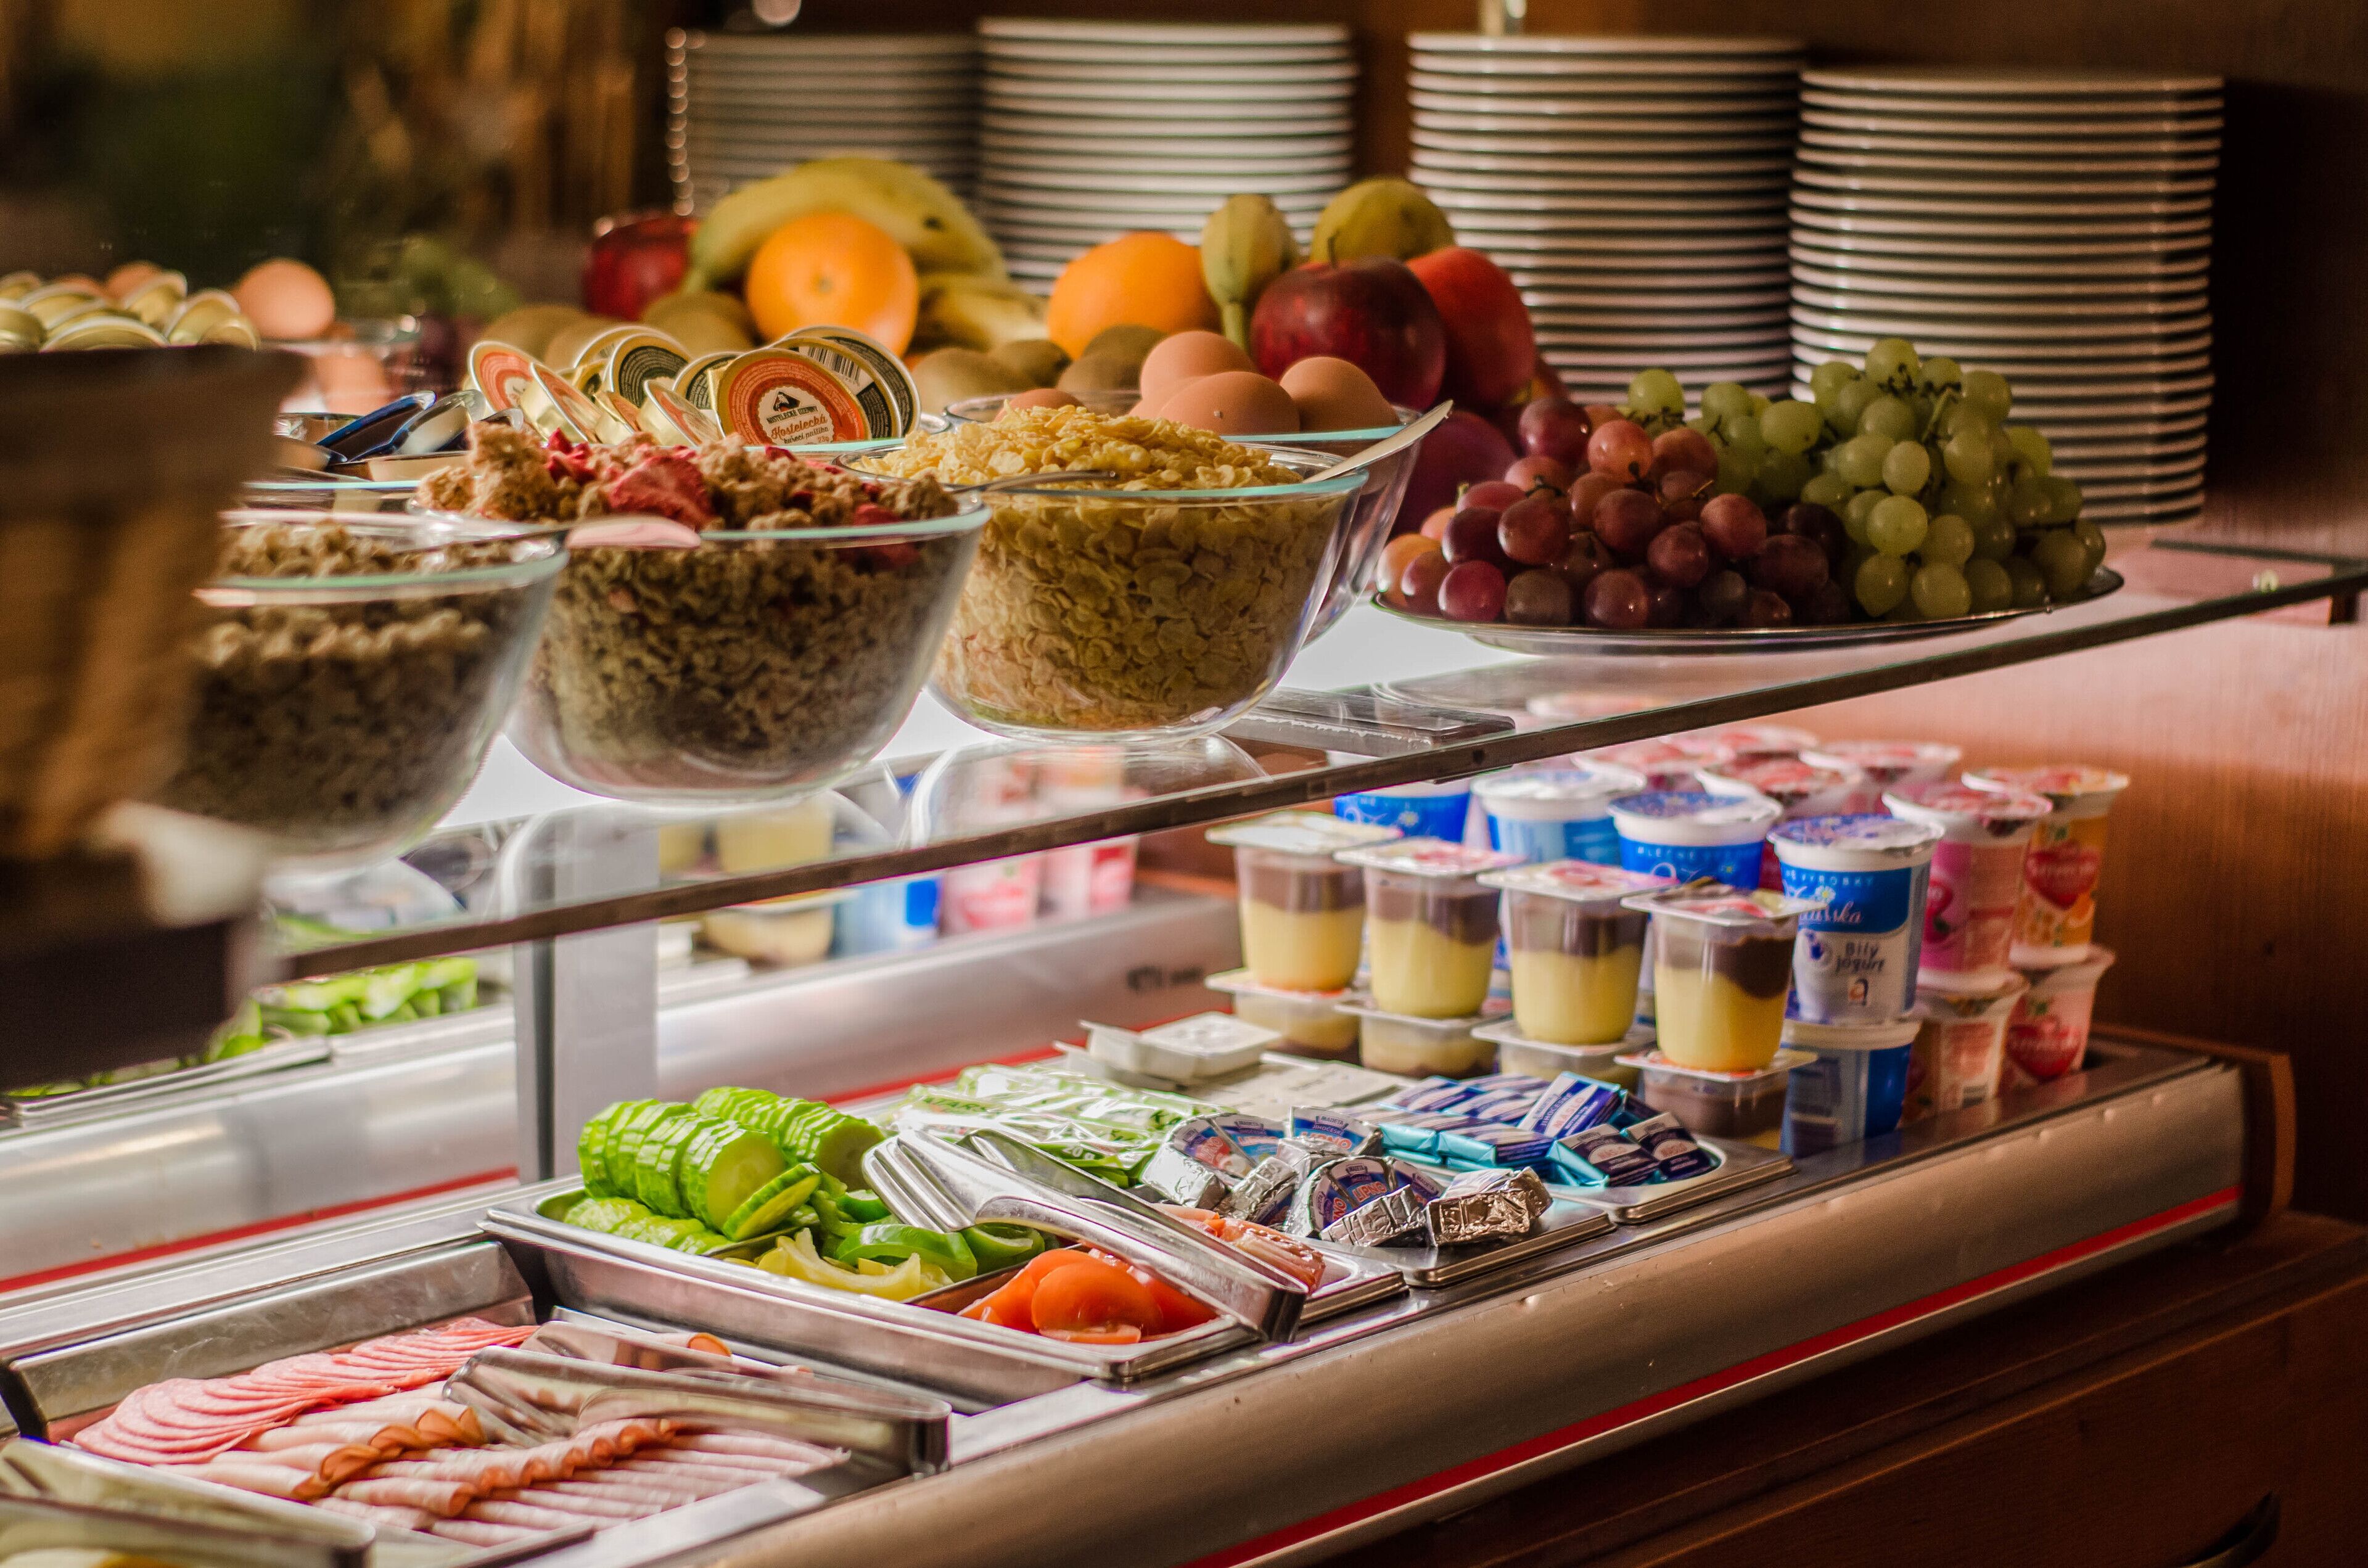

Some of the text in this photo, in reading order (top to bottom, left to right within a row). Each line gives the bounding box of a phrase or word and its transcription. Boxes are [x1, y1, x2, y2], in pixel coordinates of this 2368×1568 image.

[771, 414, 828, 440] Kostelecká
[805, 426, 829, 439] paštika
[1352, 1181, 1387, 1202] LIPNO
